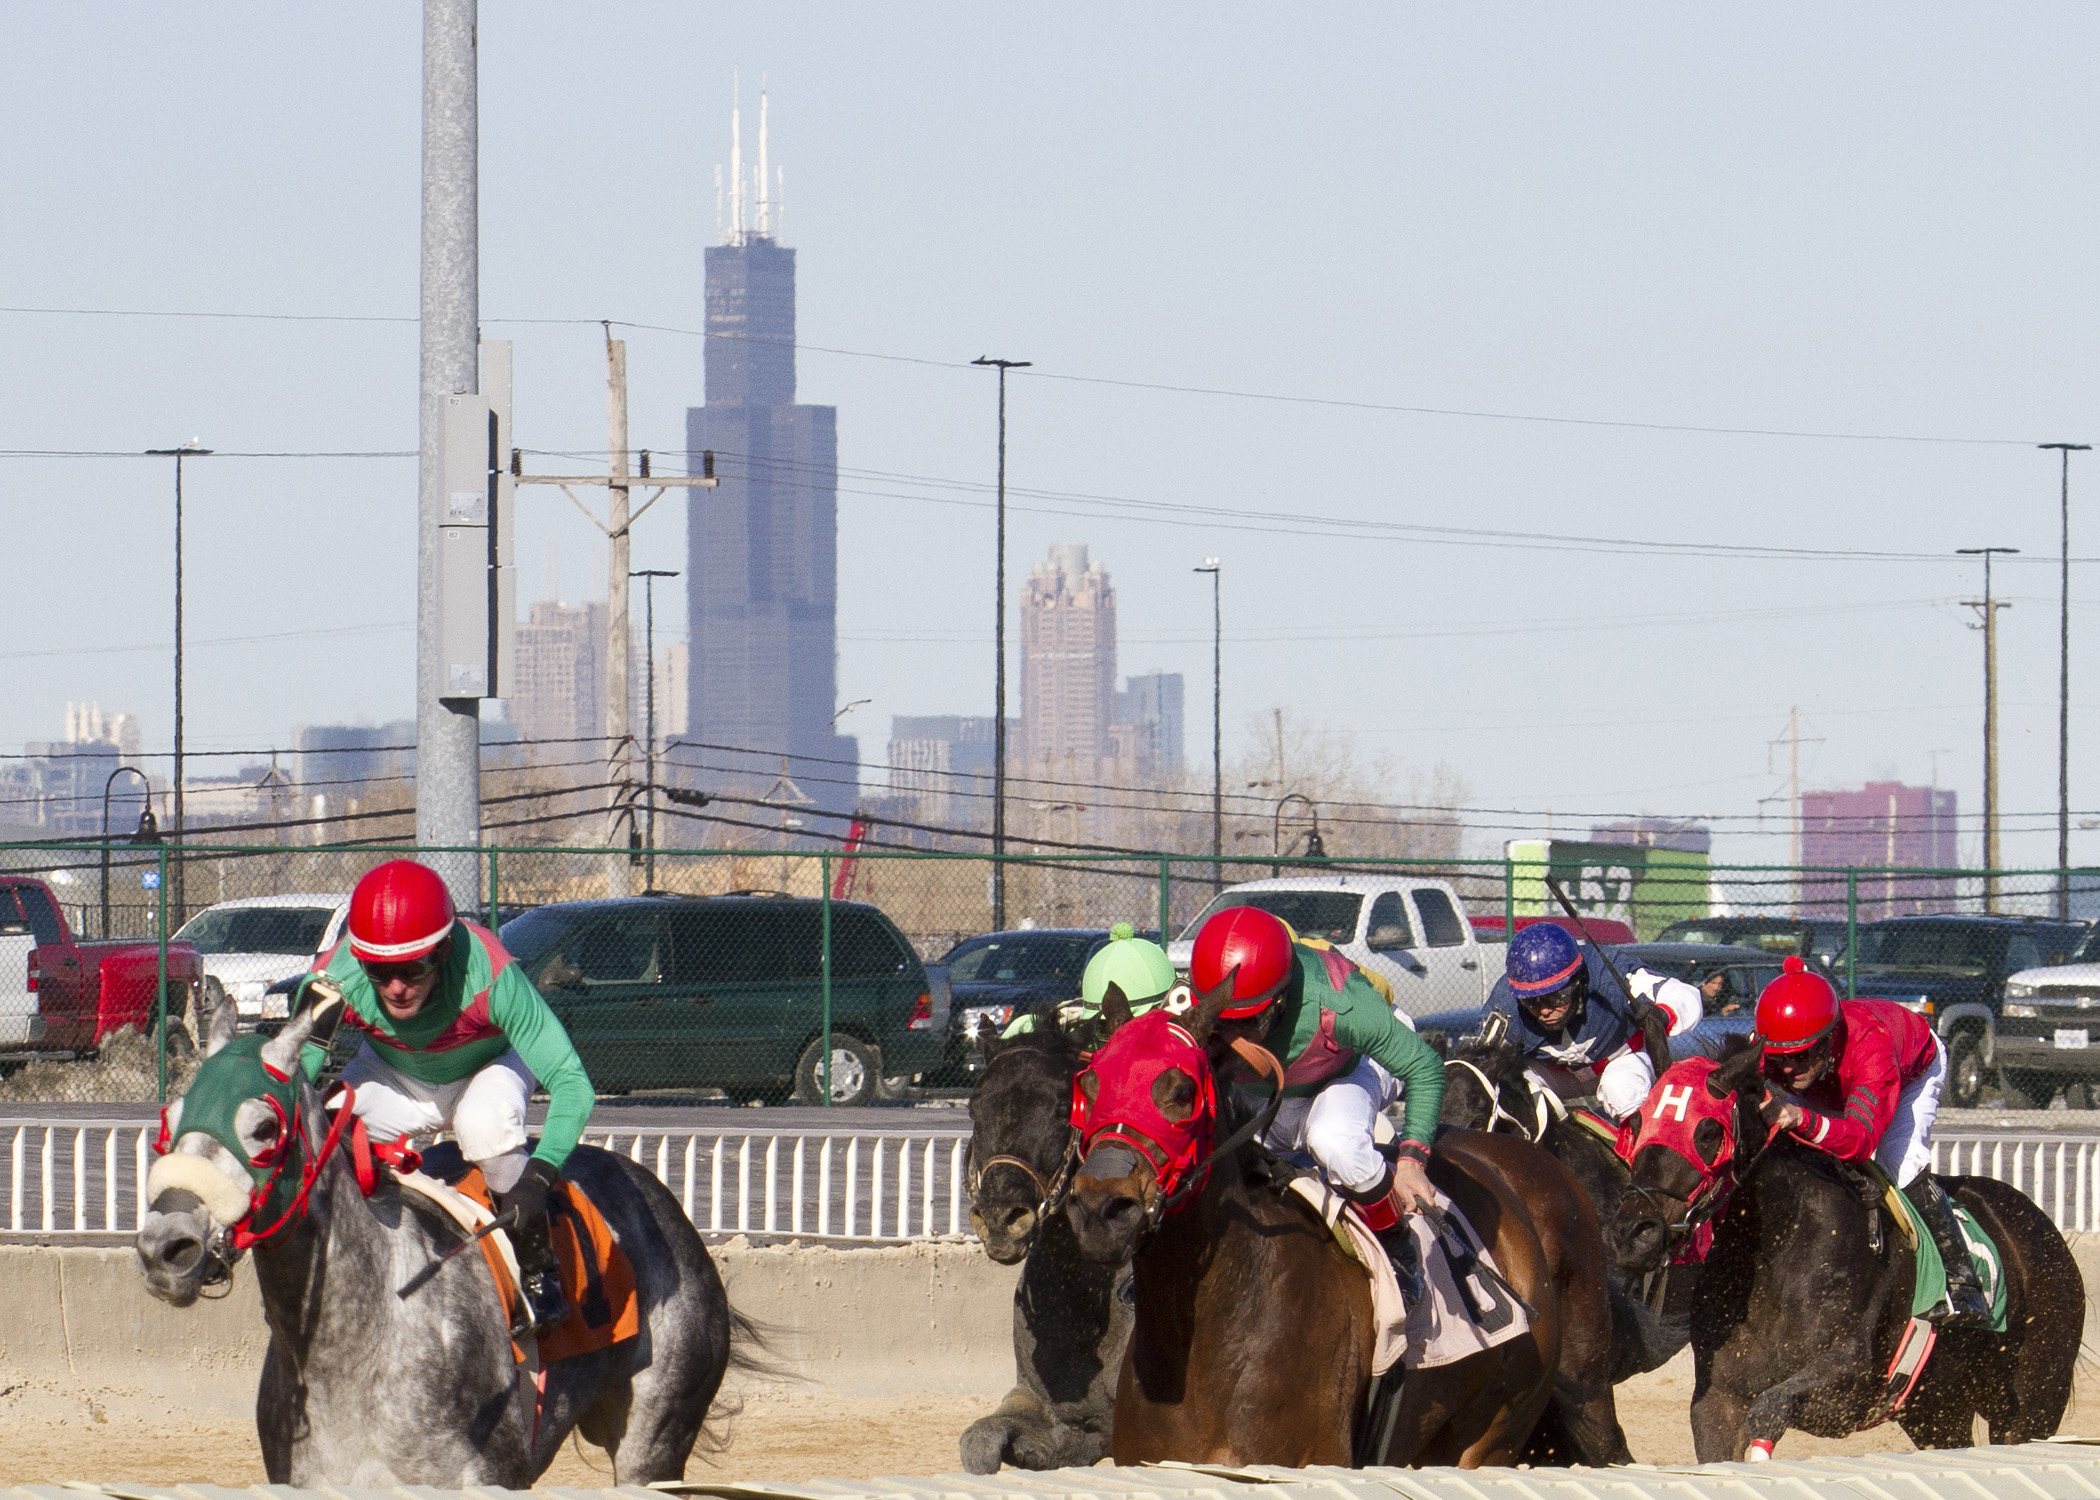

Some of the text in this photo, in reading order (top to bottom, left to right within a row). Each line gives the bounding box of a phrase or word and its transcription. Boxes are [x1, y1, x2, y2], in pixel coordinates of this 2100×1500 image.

[311, 982, 342, 1022] 7
[1652, 1083, 1693, 1122] H
[1422, 1205, 1514, 1335] 8
